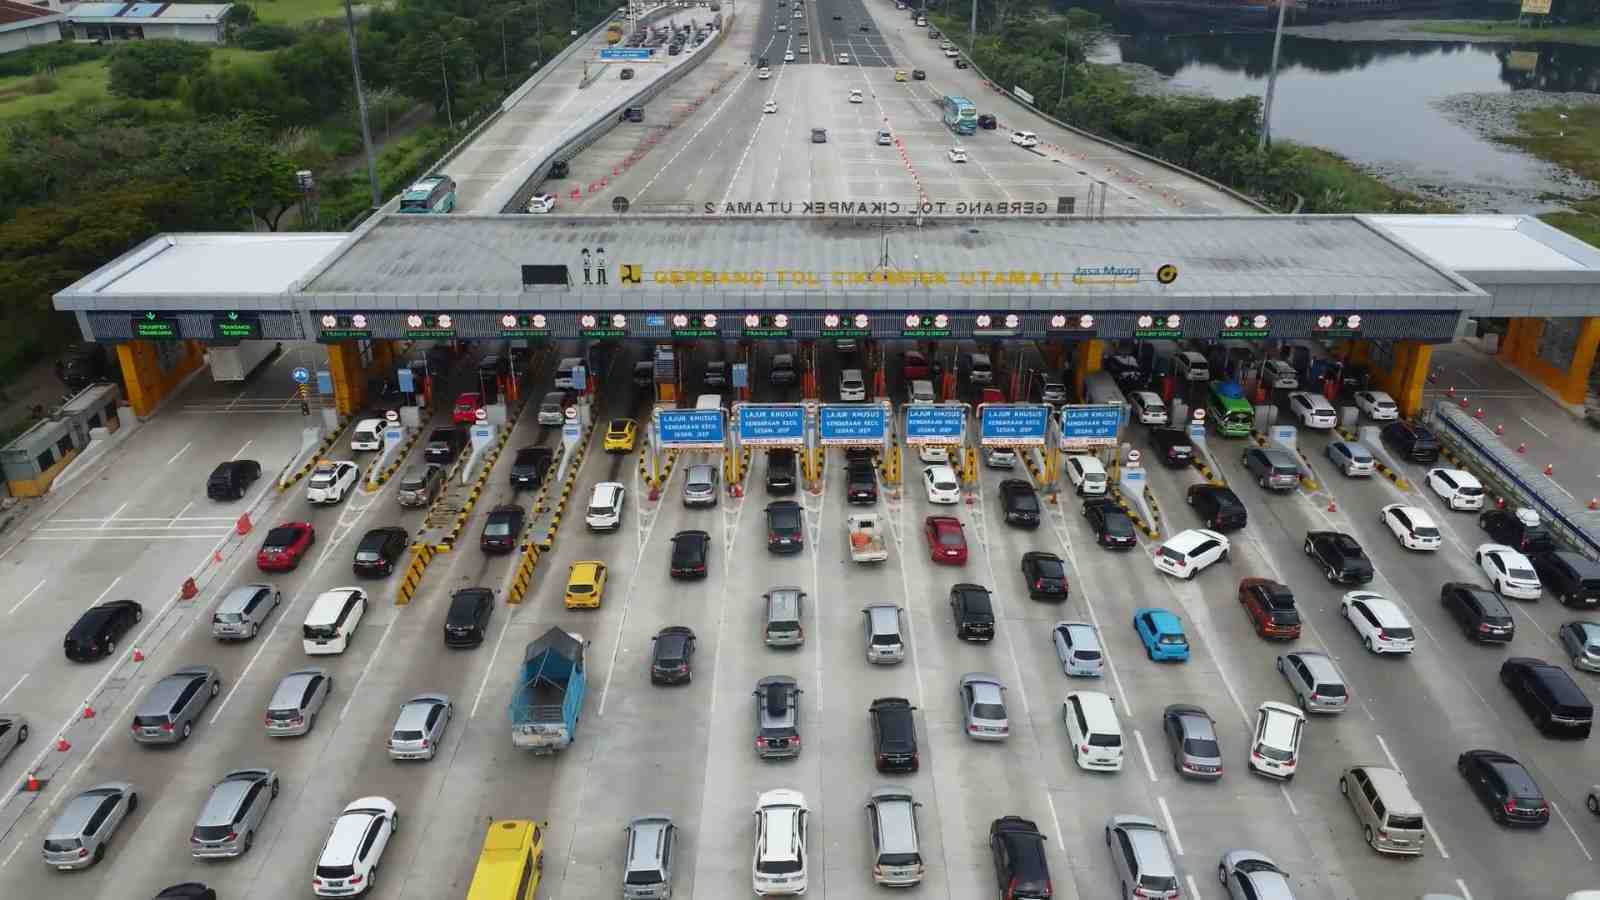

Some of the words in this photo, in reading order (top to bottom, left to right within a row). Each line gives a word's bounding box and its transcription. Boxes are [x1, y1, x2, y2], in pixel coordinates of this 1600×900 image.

[655, 270, 765, 287] GERBANG
[776, 270, 821, 288] TOL
[959, 270, 1042, 288] UTAMA
